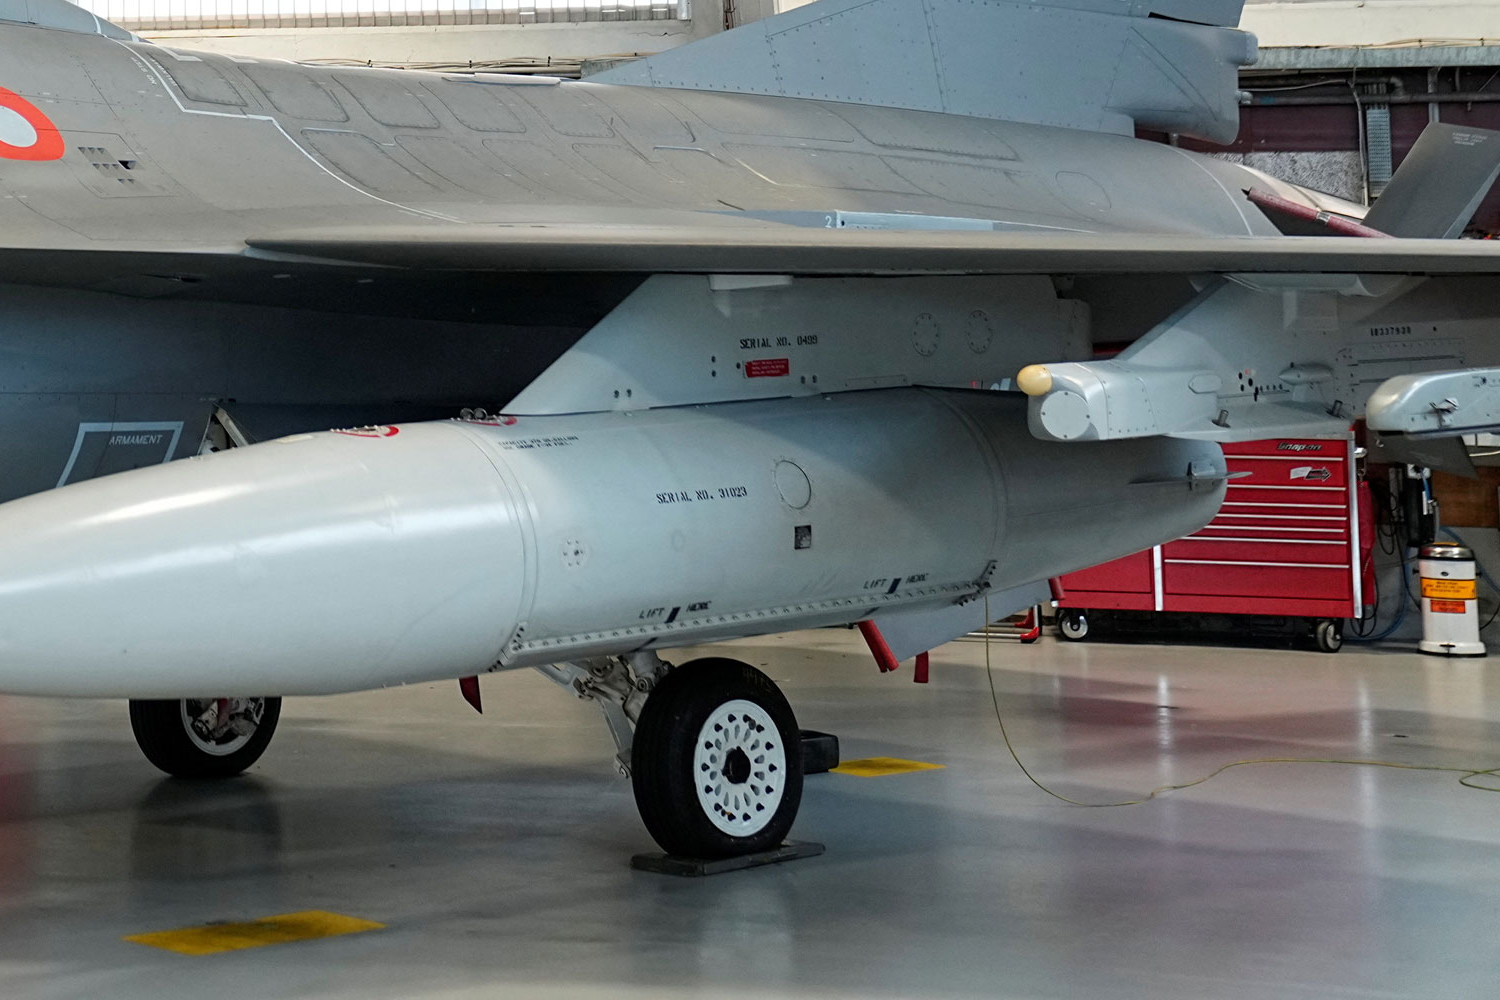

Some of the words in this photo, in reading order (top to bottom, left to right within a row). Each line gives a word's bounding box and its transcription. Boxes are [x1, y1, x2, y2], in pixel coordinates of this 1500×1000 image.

[740, 337, 772, 349] SERIAL
[776, 336, 791, 347] NO.
[797, 334, 818, 346] 0499
[109, 435, 163, 446] ARMAMENT
[1276, 441, 1322, 452] Snap-on
[656, 490, 692, 504] SERIAL
[695, 489, 714, 501] NO.
[718, 486, 748, 499] 31023
[863, 578, 887, 590] LIFT
[639, 607, 665, 619] LIFT
